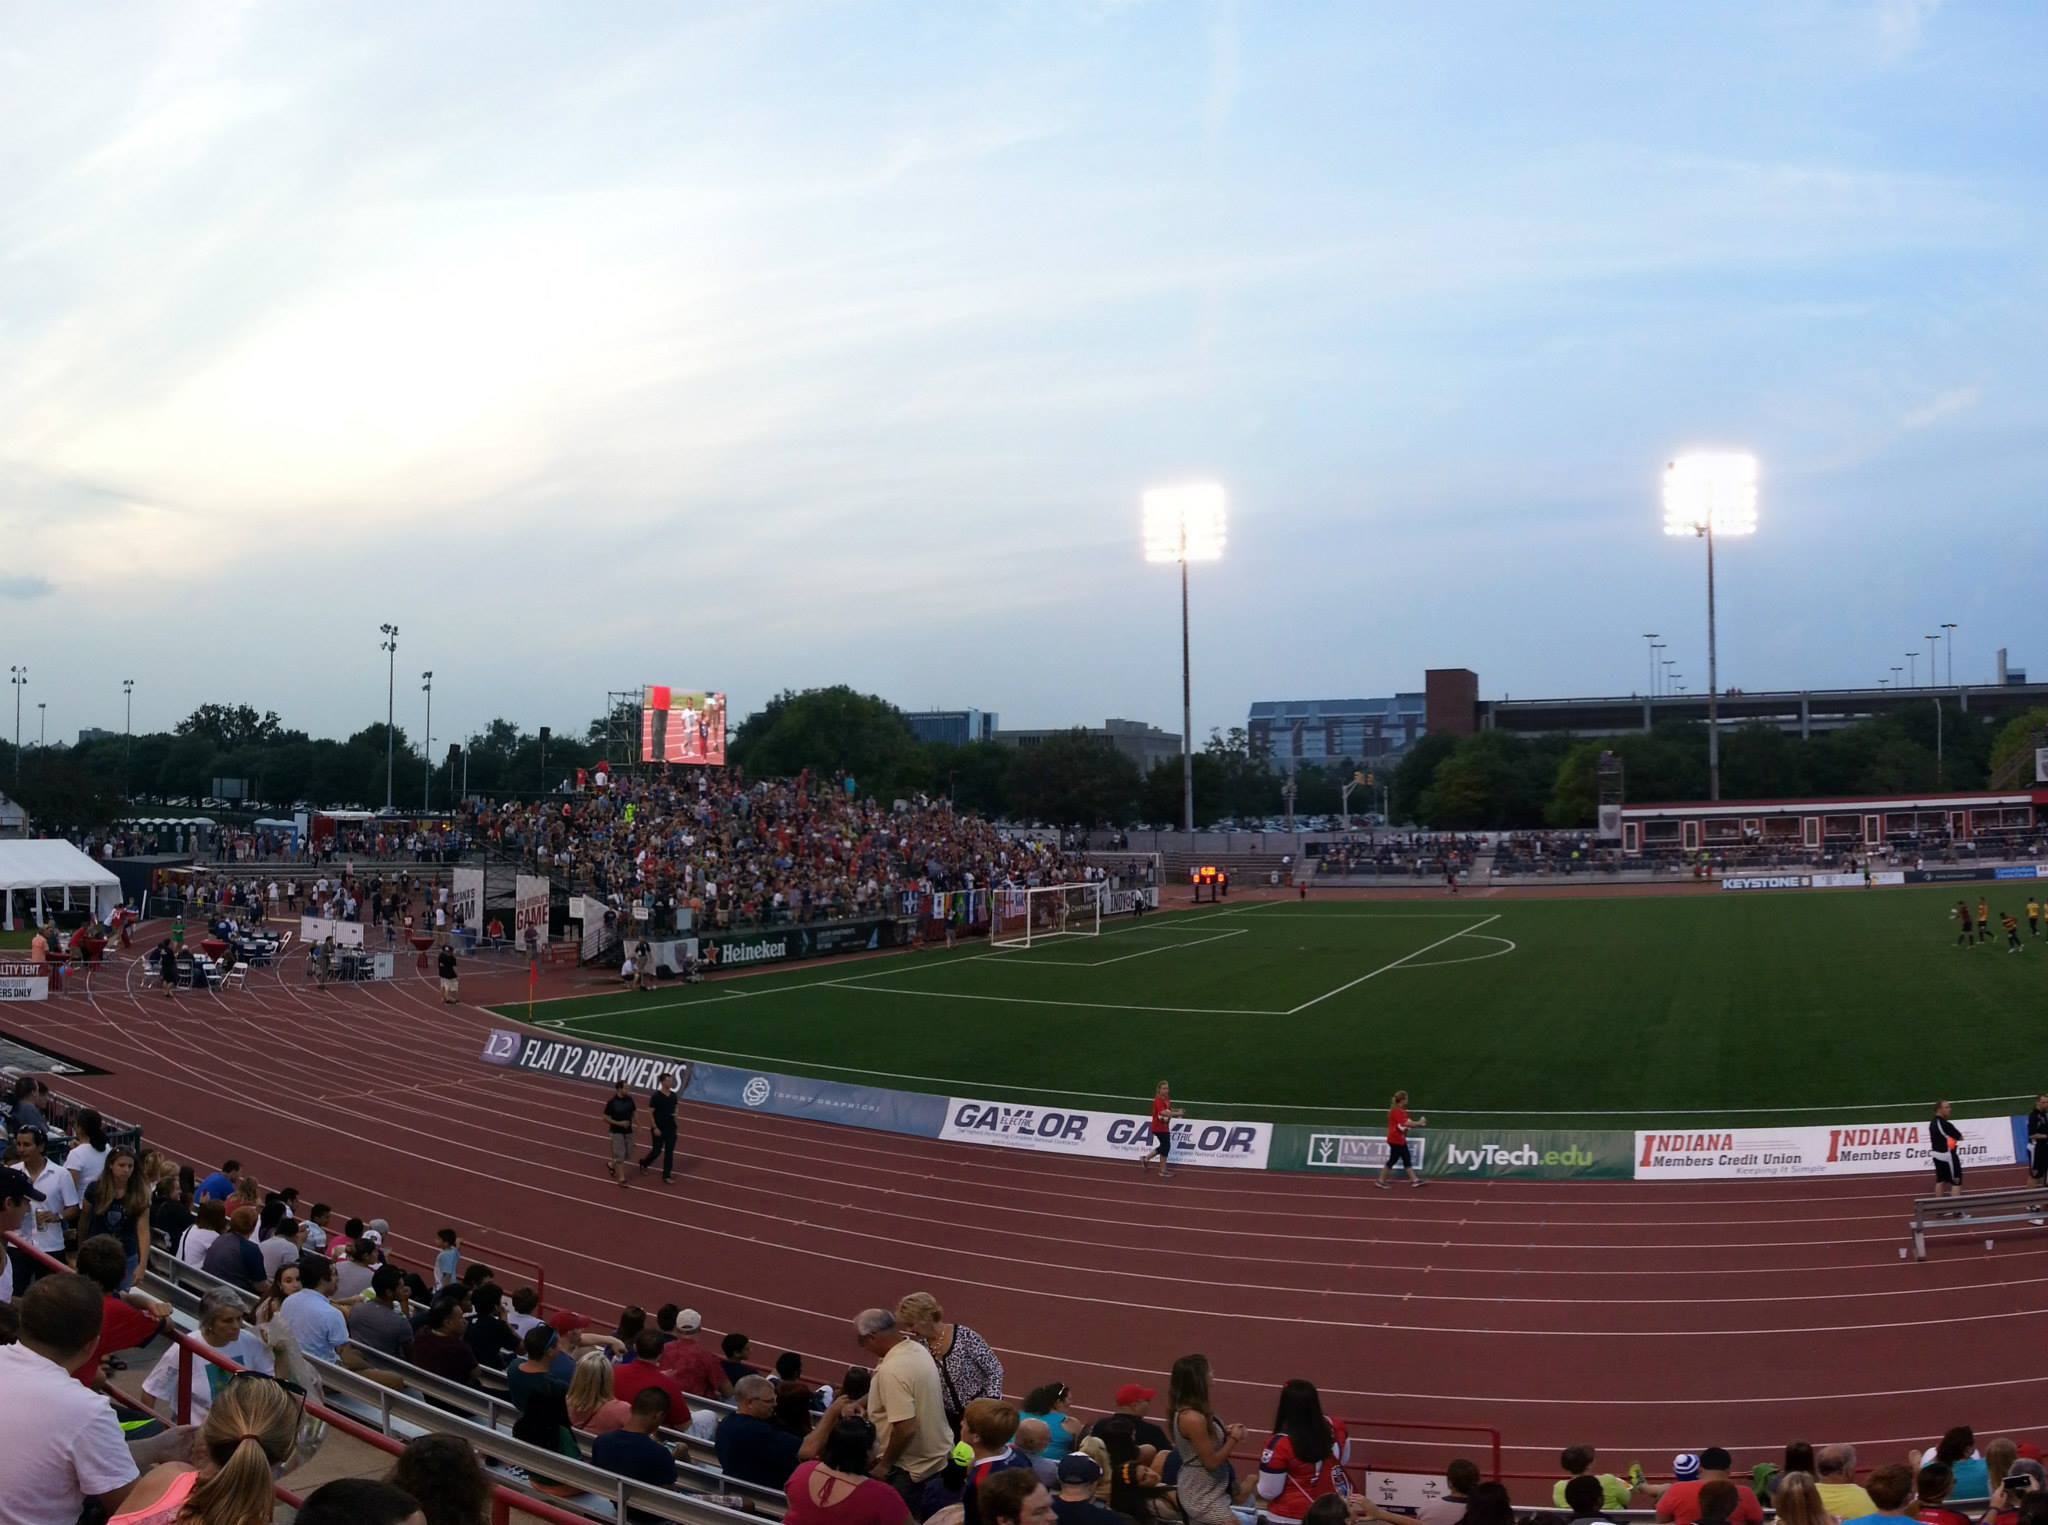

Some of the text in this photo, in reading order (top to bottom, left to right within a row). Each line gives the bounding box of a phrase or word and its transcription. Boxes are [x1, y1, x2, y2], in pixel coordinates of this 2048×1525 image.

[1723, 877, 1798, 888] KEYSTONE
[517, 904, 548, 930] GAME
[722, 940, 786, 964] Heineken
[20, 965, 40, 975] TENT
[14, 988, 31, 998] ONLY
[484, 1034, 513, 1058] 12
[954, 1104, 1089, 1140] GAYLOR
[1000, 1116, 1034, 1128] ELECTRIC
[1344, 1141, 1371, 1155] IVY
[1639, 1133, 1733, 1167] INDIANA
[1826, 1127, 1919, 1163] INDIANA
[1840, 1149, 1901, 1162] Members
[1959, 1144, 1987, 1155] nion
[1447, 1144, 1593, 1171] IvyTech.edu
[1652, 1153, 1802, 1167] Members Credit Union
[1736, 1167, 1777, 1175] Keeping
[1791, 1166, 1826, 1174] Simple
[1384, 1492, 1393, 1500] 14
